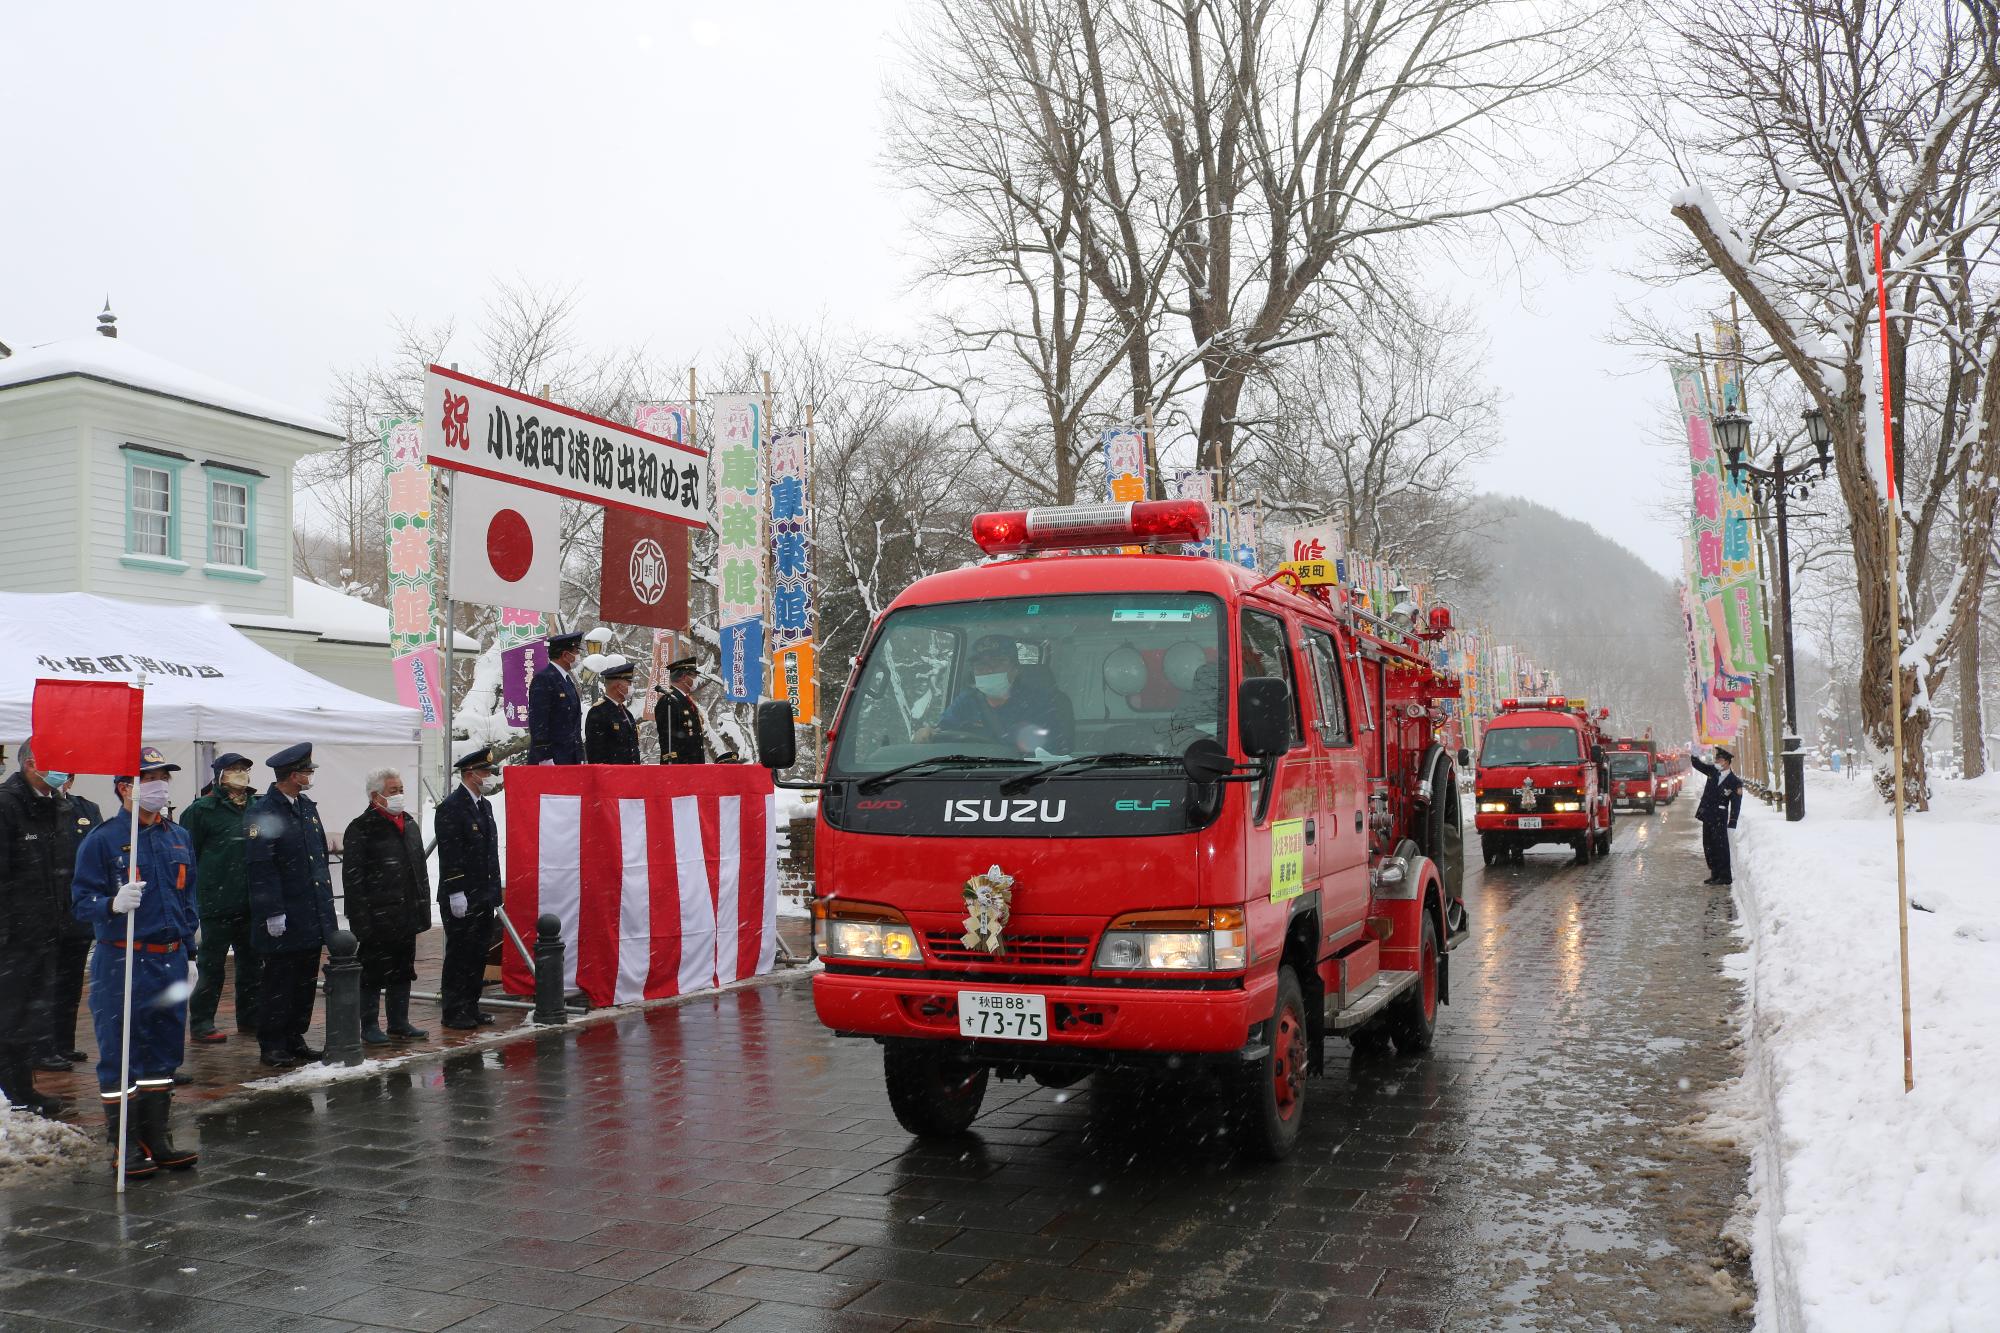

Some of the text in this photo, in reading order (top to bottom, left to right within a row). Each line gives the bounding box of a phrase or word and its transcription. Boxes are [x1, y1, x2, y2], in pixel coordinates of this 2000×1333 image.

[441, 388, 700, 510] 祝 小坂町消防出初め式
[388, 463, 433, 635] 康楽館
[721, 444, 758, 605] 康楽館
[770, 476, 808, 630] 康楽館
[36, 654, 224, 678] 小坂町消防団
[944, 799, 1067, 823] ISUZU
[1115, 799, 1171, 811] ELF
[965, 1010, 1042, 1037] す 73-75
